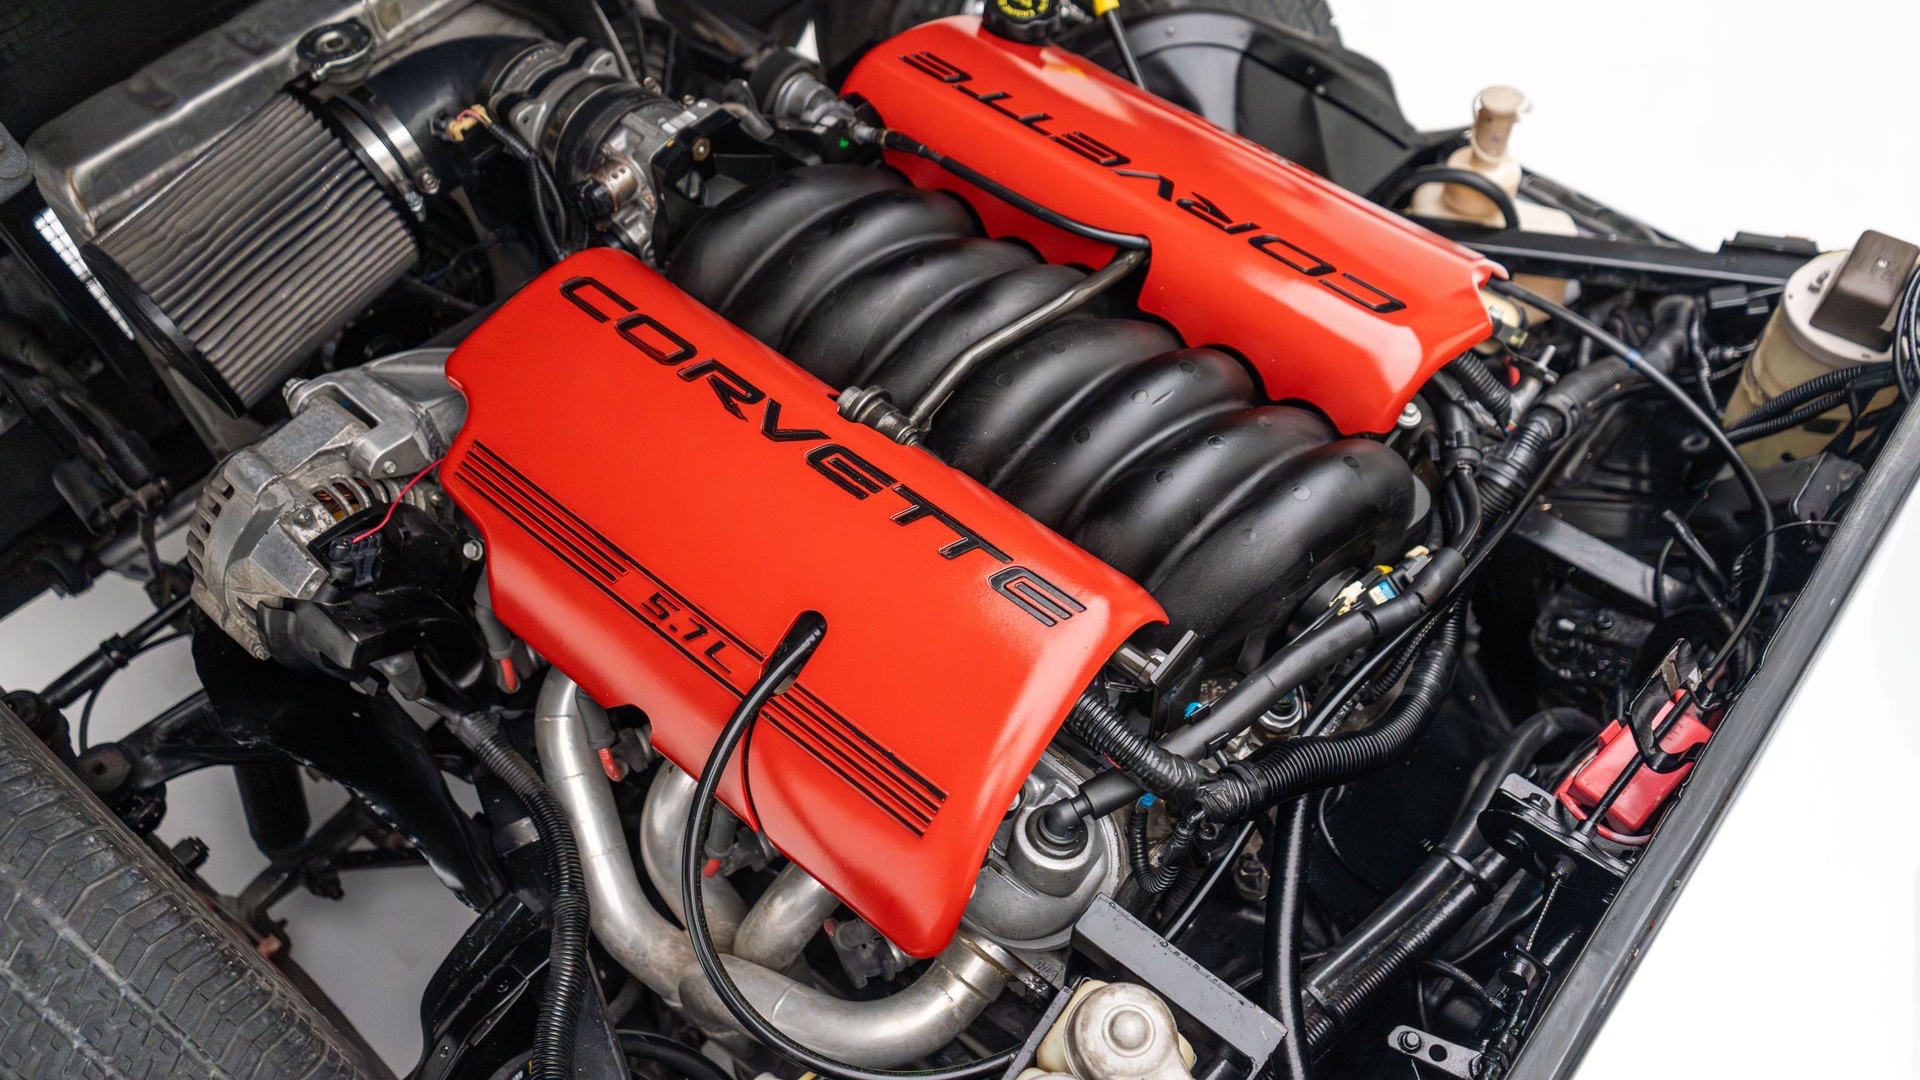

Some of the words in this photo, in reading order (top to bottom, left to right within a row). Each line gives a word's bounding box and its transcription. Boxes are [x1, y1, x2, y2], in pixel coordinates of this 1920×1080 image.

[898, 51, 1407, 313] CORVETTE
[559, 276, 1087, 627] CORVETTE
[641, 592, 732, 674] 5.7L
